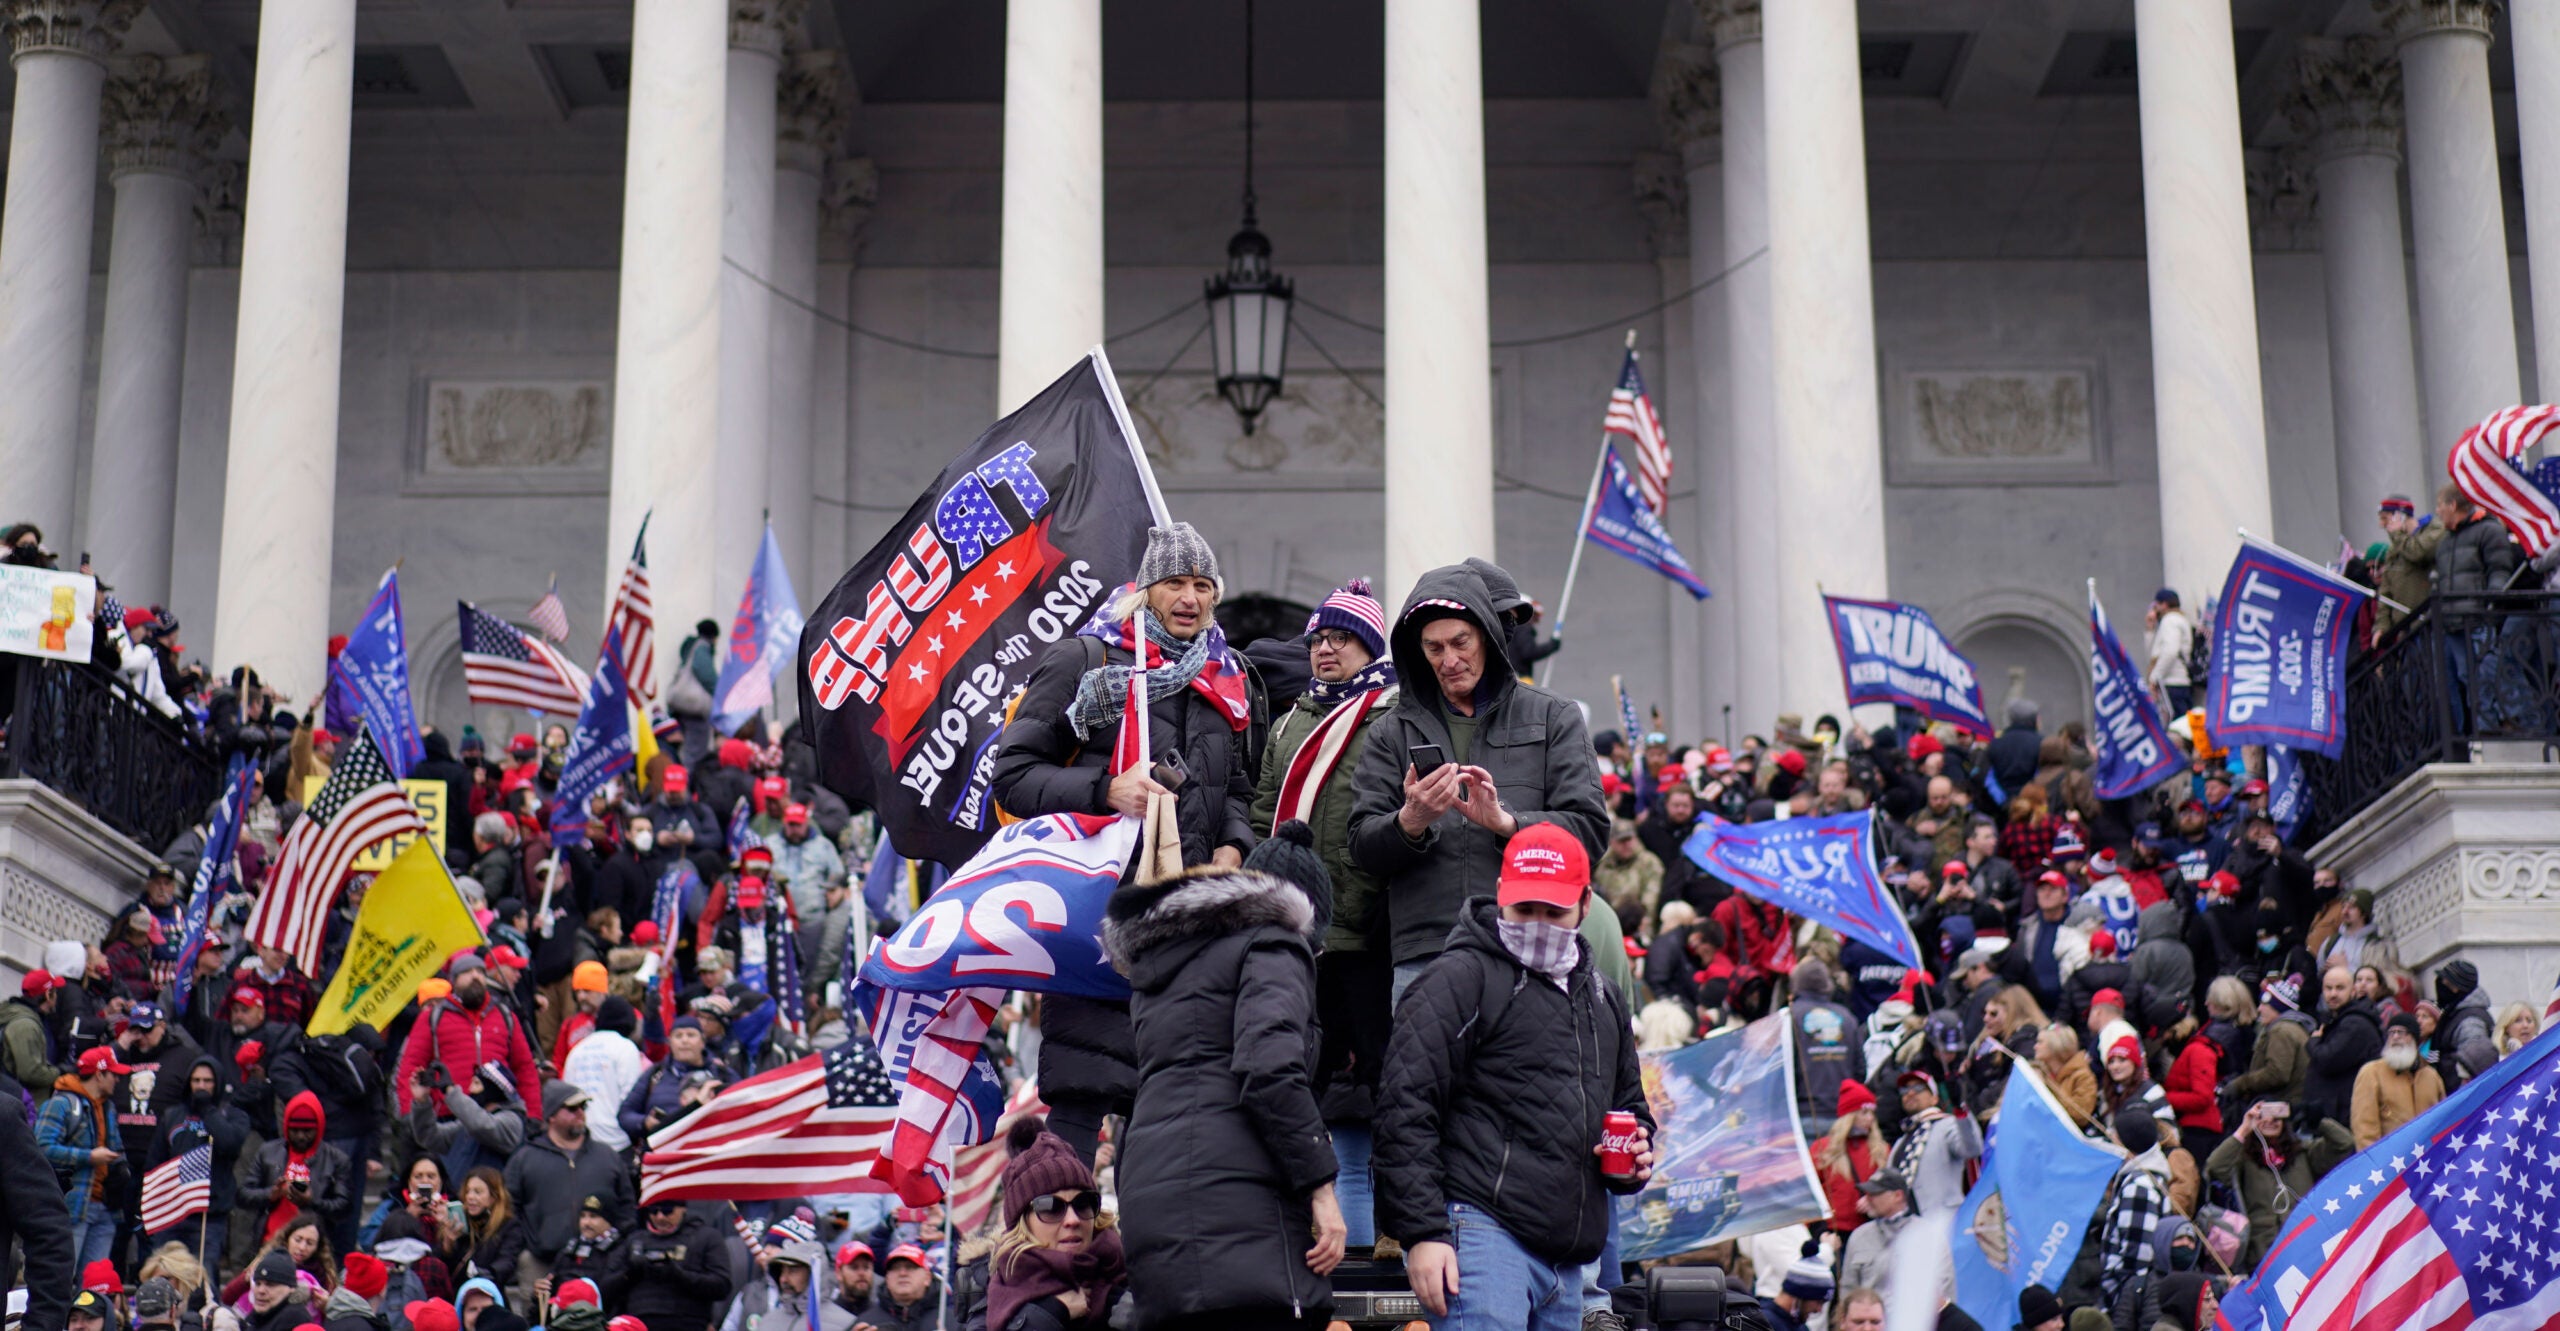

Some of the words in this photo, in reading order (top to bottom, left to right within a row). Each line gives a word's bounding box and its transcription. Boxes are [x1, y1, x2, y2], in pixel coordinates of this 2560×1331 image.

[1838, 604, 1975, 694] TRUMP
[2092, 645, 2157, 767] RUMP
[1514, 848, 1565, 864] AMERICA
[1520, 866, 1541, 874] TRUMP
